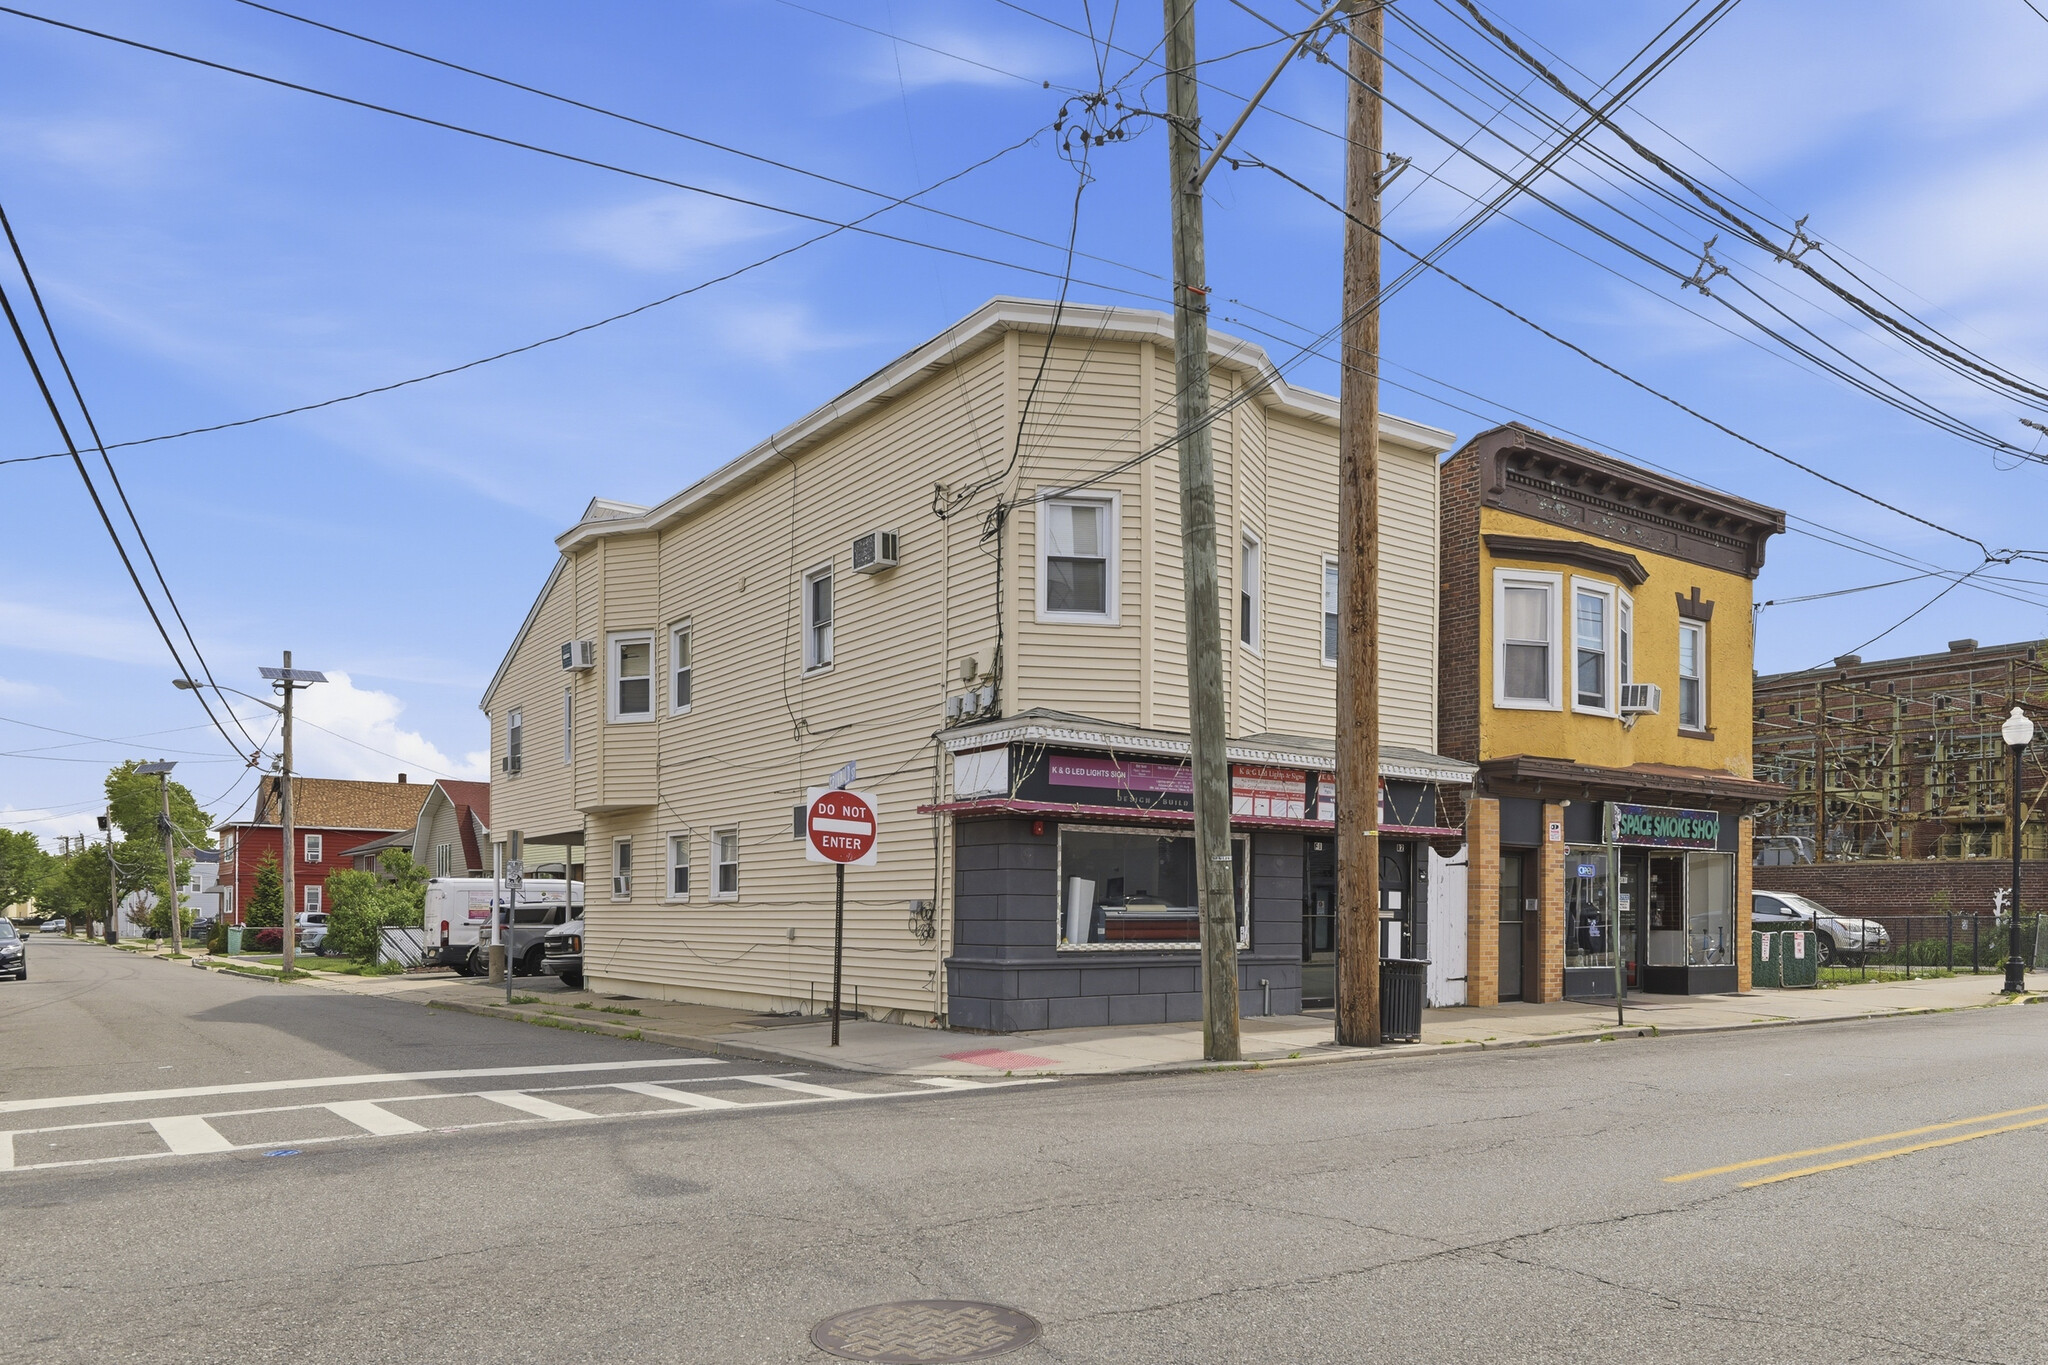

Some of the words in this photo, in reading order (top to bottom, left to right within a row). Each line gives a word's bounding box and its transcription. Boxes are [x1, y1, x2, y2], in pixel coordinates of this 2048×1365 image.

[1086, 769, 1109, 777] LIGHTS
[1117, 795, 1151, 804] DESIGN
[818, 803, 835, 815] DO
[842, 805, 867, 819] NOT
[1620, 814, 1652, 836] SPACE
[1653, 816, 1691, 839] SMOKE
[1691, 819, 1720, 840] SHOP
[822, 835, 861, 850] ENTER
